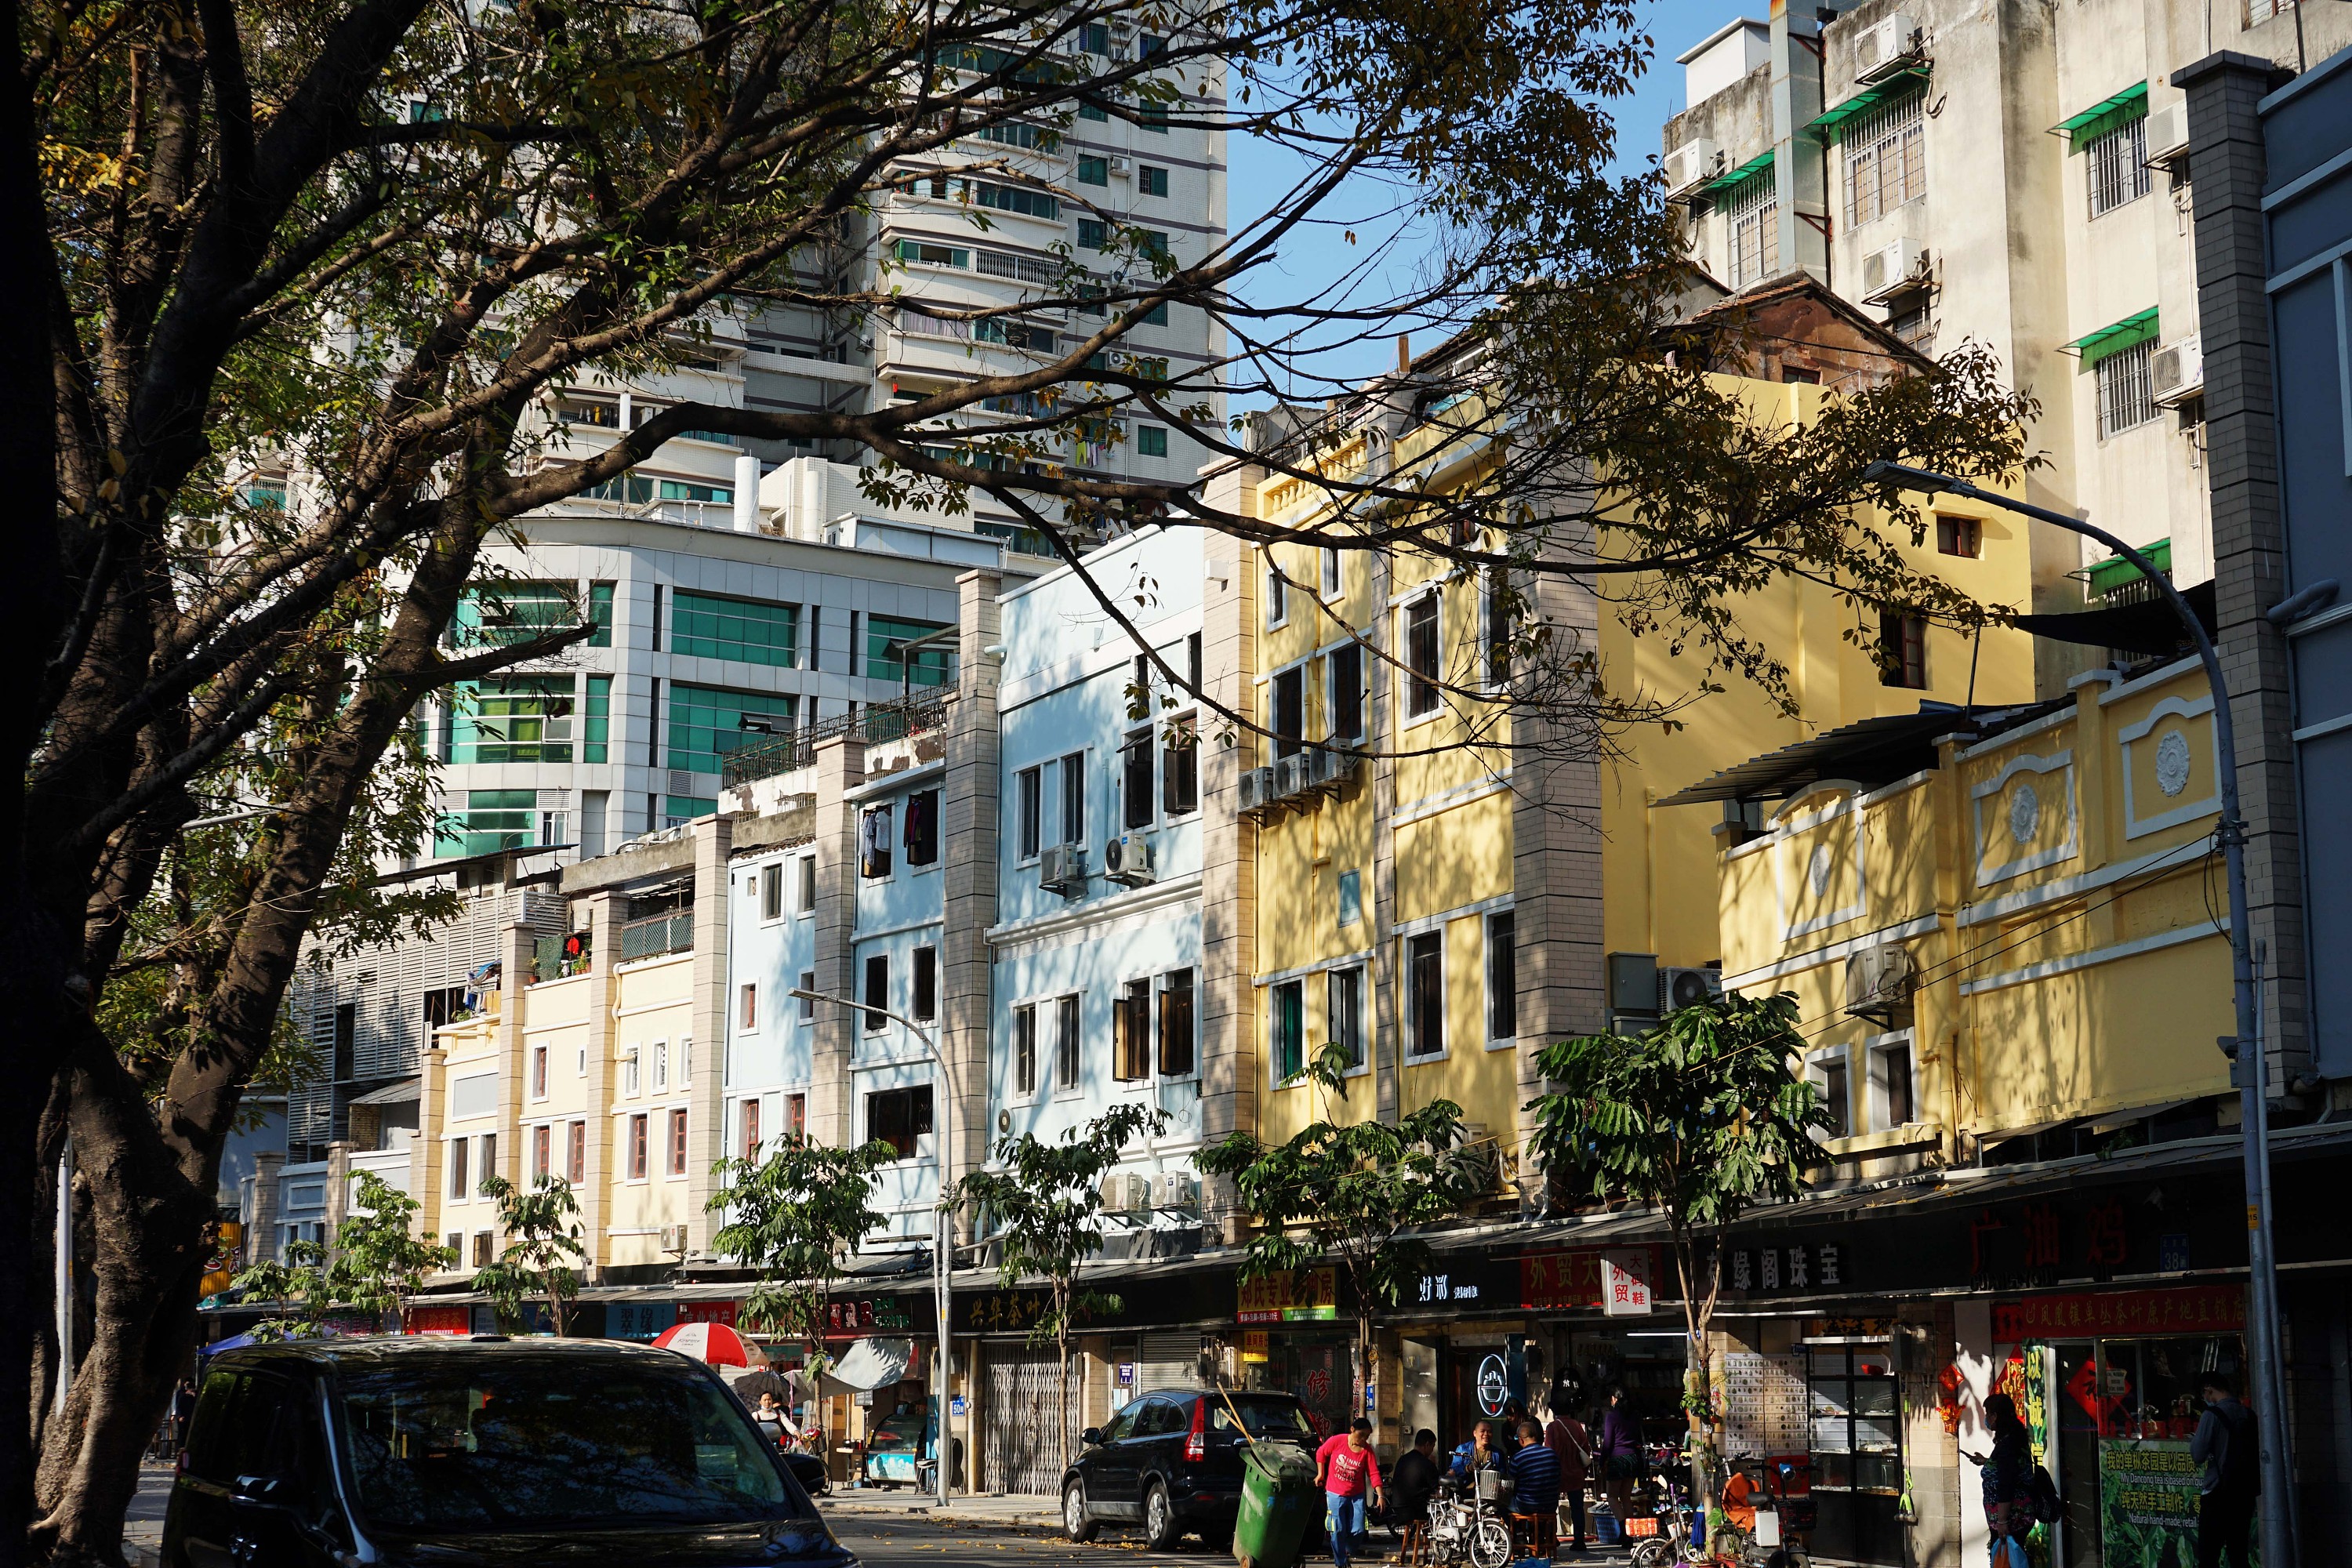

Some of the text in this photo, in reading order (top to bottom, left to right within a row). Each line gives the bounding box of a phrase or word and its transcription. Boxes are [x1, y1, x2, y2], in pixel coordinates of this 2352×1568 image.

[1707, 1243, 1841, 1290] 有缘阁珠宝
[2165, 1252, 2180, 1271] 38
[1613, 1263, 1629, 1303] 外贸
[1630, 1254, 1646, 1305] 大码鞋
[2120, 1472, 2130, 1483] My
[2154, 1475, 2163, 1484] tea
[2164, 1475, 2169, 1484] is
[2169, 1475, 2187, 1486] based
[2187, 1478, 2194, 1487] on
[2129, 1512, 2149, 1525] Natural
[2183, 1515, 2197, 1528] retail
